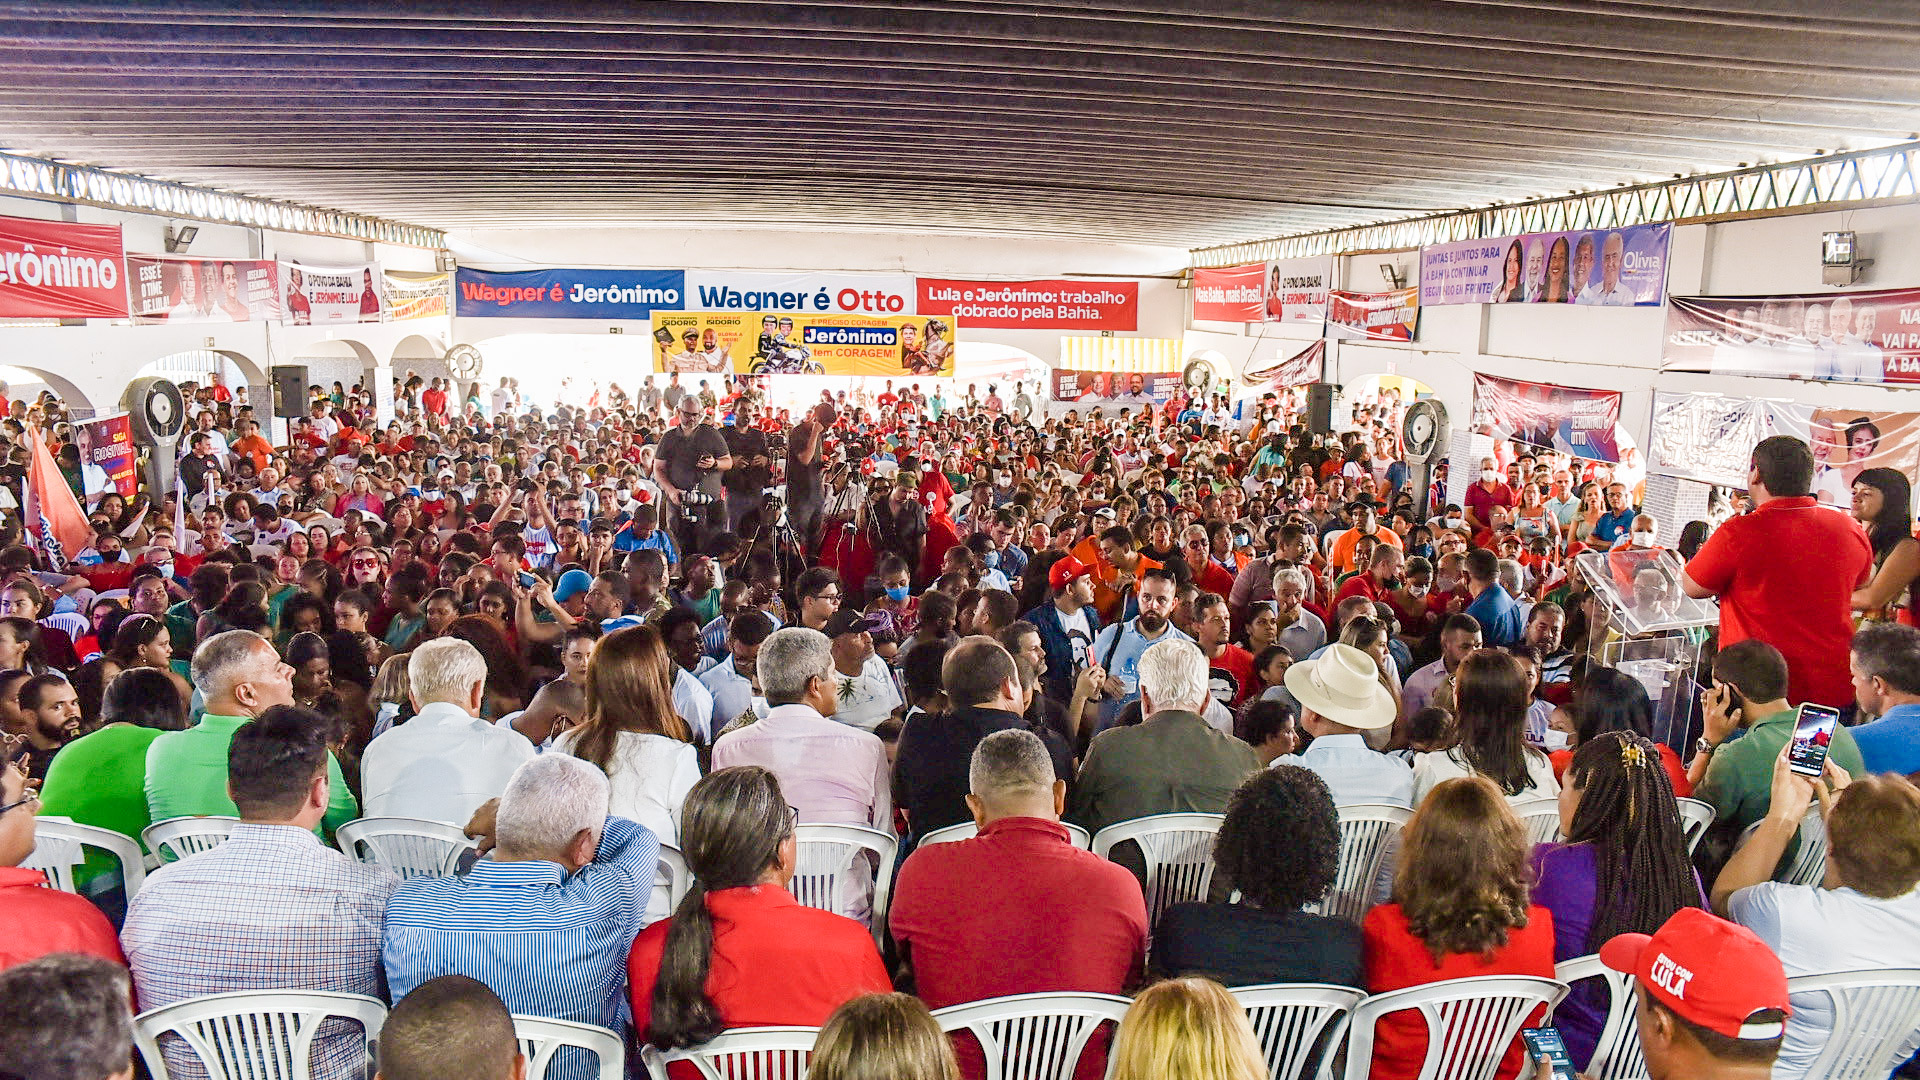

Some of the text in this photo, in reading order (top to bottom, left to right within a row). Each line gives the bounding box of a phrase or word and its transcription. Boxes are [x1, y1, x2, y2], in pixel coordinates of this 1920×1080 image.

[1426, 247, 1500, 268] JUNTAS E JUNTOS PARA
[1624, 251, 1660, 270] Olívia
[140, 266, 157, 281] ESSE
[1425, 265, 1488, 281] A BAHIA CONTINUAR
[147, 281, 163, 296] TIME
[313, 275, 327, 287] POVO
[328, 276, 336, 287] DA
[336, 276, 352, 288] BAHIA
[1306, 275, 1322, 288] BAHIA
[346, 293, 359, 304] LULA
[462, 282, 546, 306] Wagner
[550, 283, 564, 301] é
[569, 284, 679, 304] Jerônimo
[698, 285, 904, 312] Wagner é Otto
[928, 286, 1126, 305] Lula e Jerônimo: trabalho
[1195, 284, 1263, 306] Mais Bahia, mais Brasil.
[1312, 292, 1325, 304] LULA
[952, 304, 1102, 321] dobrado pela Bahia.
[805, 328, 895, 344] Jerônimo
[1882, 333, 1905, 349] VAI
[836, 348, 896, 358] CORAGEM!
[1886, 356, 1897, 372] A
[113, 432, 126, 442] SIGA
[1571, 432, 1586, 445] OTTO
[94, 441, 132, 462] ROSIVAL
[1526, 734, 1544, 743] ULA
[1657, 952, 1694, 982] ESTOU COM
[1651, 960, 1685, 1000] LULA
